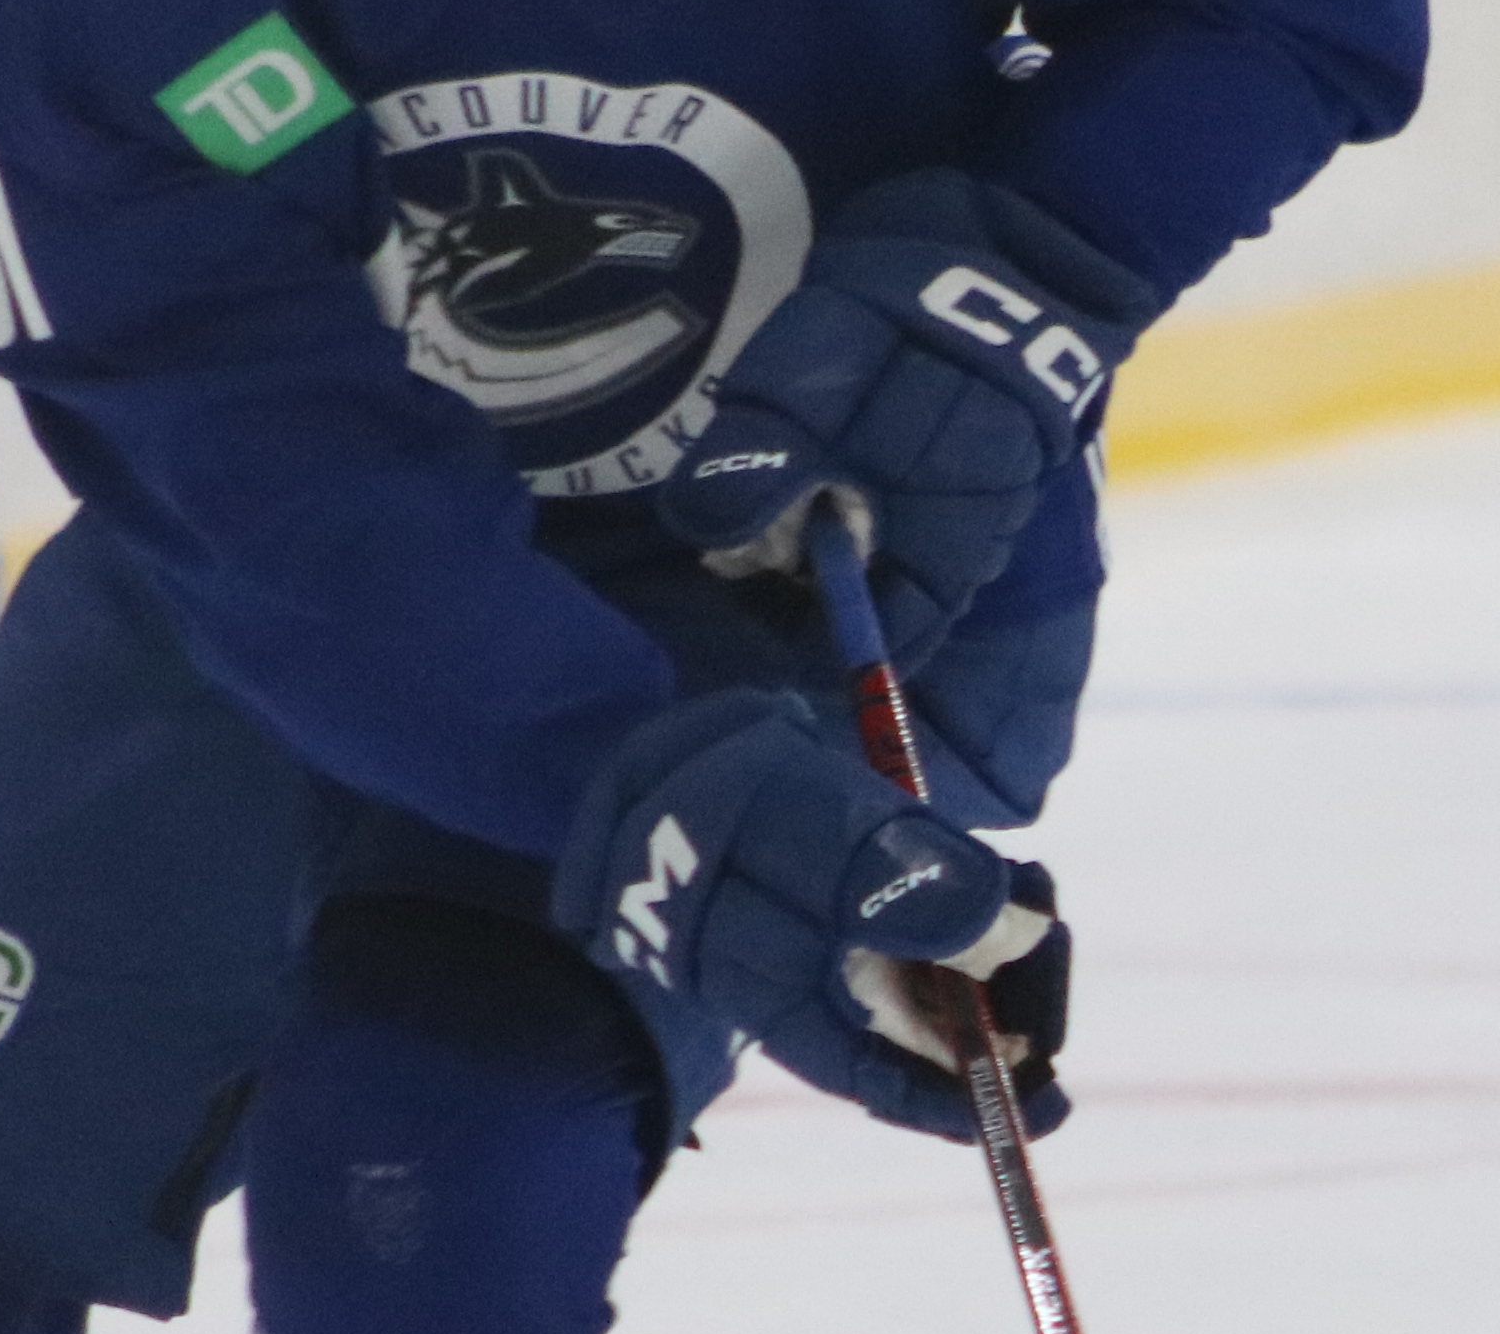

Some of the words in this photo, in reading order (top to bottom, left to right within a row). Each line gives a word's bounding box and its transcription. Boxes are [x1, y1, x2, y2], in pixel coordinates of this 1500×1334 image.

[182, 48, 317, 146] TD
[378, 78, 706, 148] COUVER
[918, 266, 1106, 421] CC
[694, 452, 788, 479] CCM
[860, 863, 941, 919] CCM
